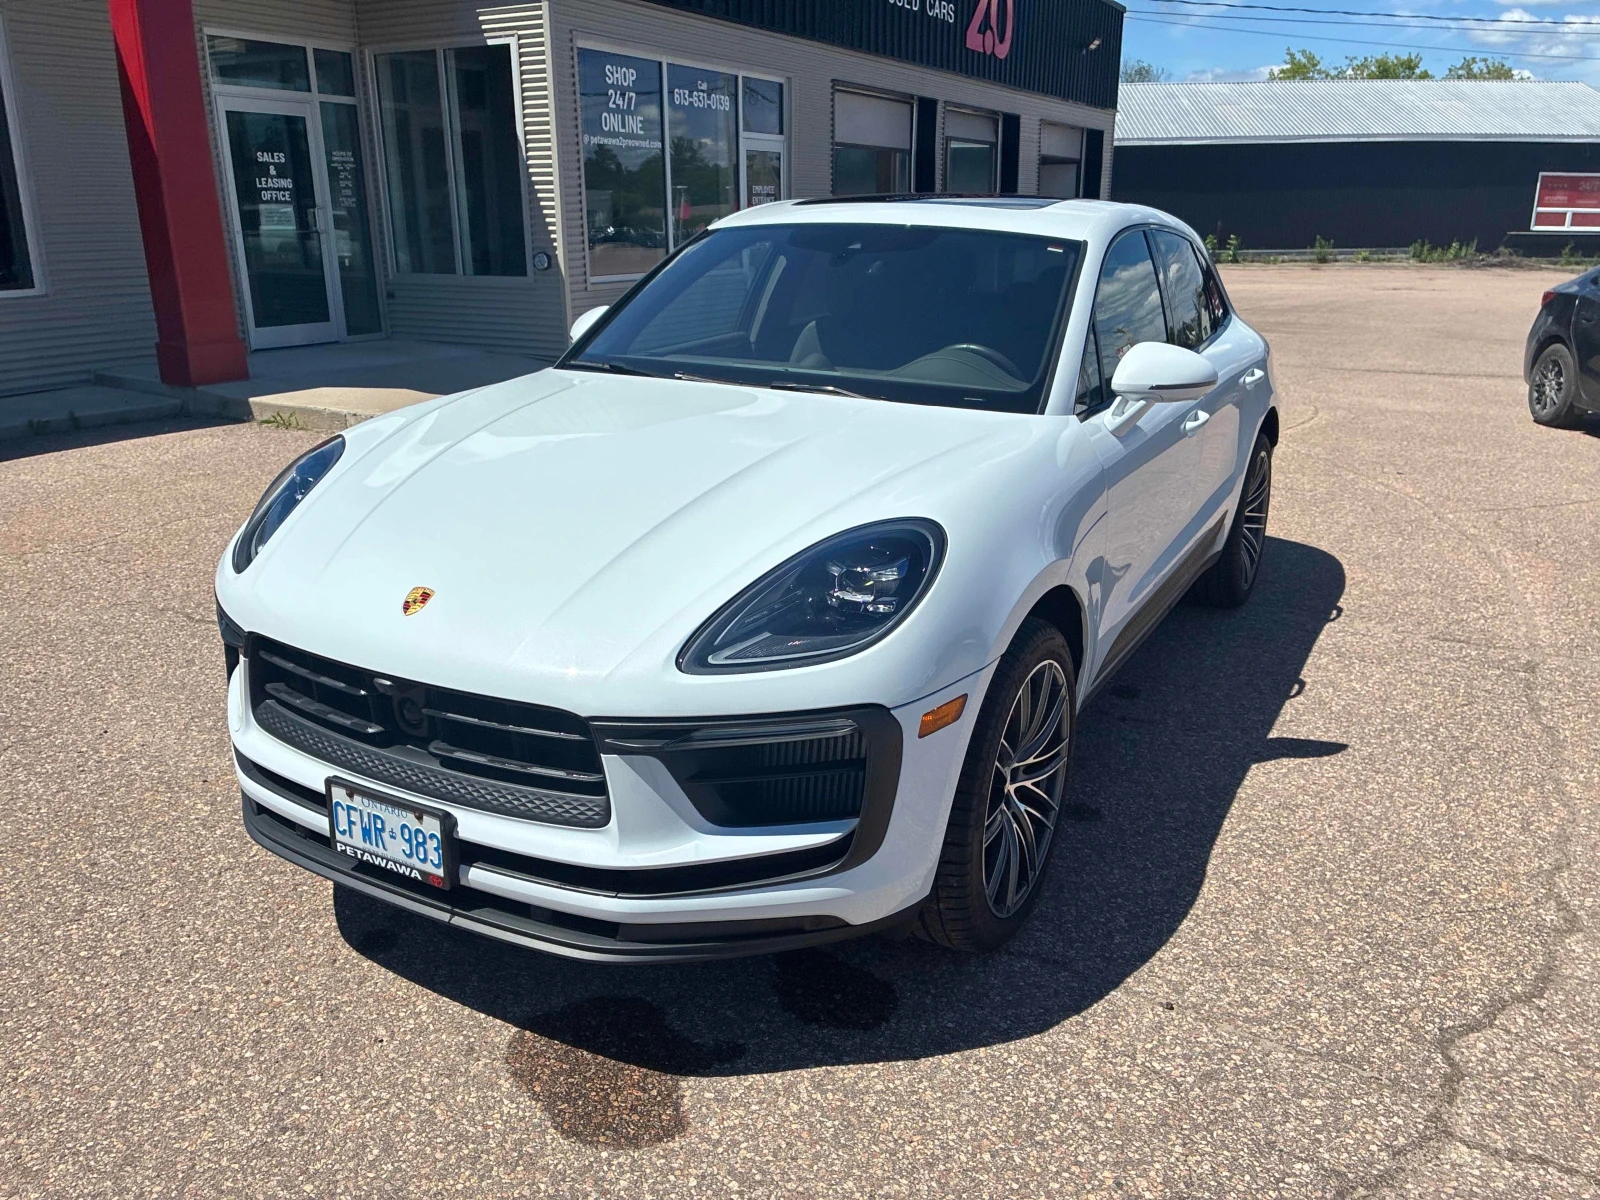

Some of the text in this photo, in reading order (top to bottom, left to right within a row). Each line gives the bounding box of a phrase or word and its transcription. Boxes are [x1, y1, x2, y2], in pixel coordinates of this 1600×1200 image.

[927, 0, 955, 23] CARS
[605, 64, 637, 87] SHOP
[697, 81, 708, 90] Call
[608, 89, 636, 111] 24/7
[674, 88, 730, 111] 613-631-0139
[601, 112, 645, 135] ONLINE
[257, 152, 285, 163] SALES
[269, 165, 277, 175] &
[256, 177, 293, 189] LEASING
[752, 185, 775, 194] EMPLOYEE
[261, 191, 291, 200] OFFICE
[361, 797, 407, 818] ONTARIO
[333, 800, 442, 869] CFWR 983
[336, 842, 422, 880] PETAWAWA
